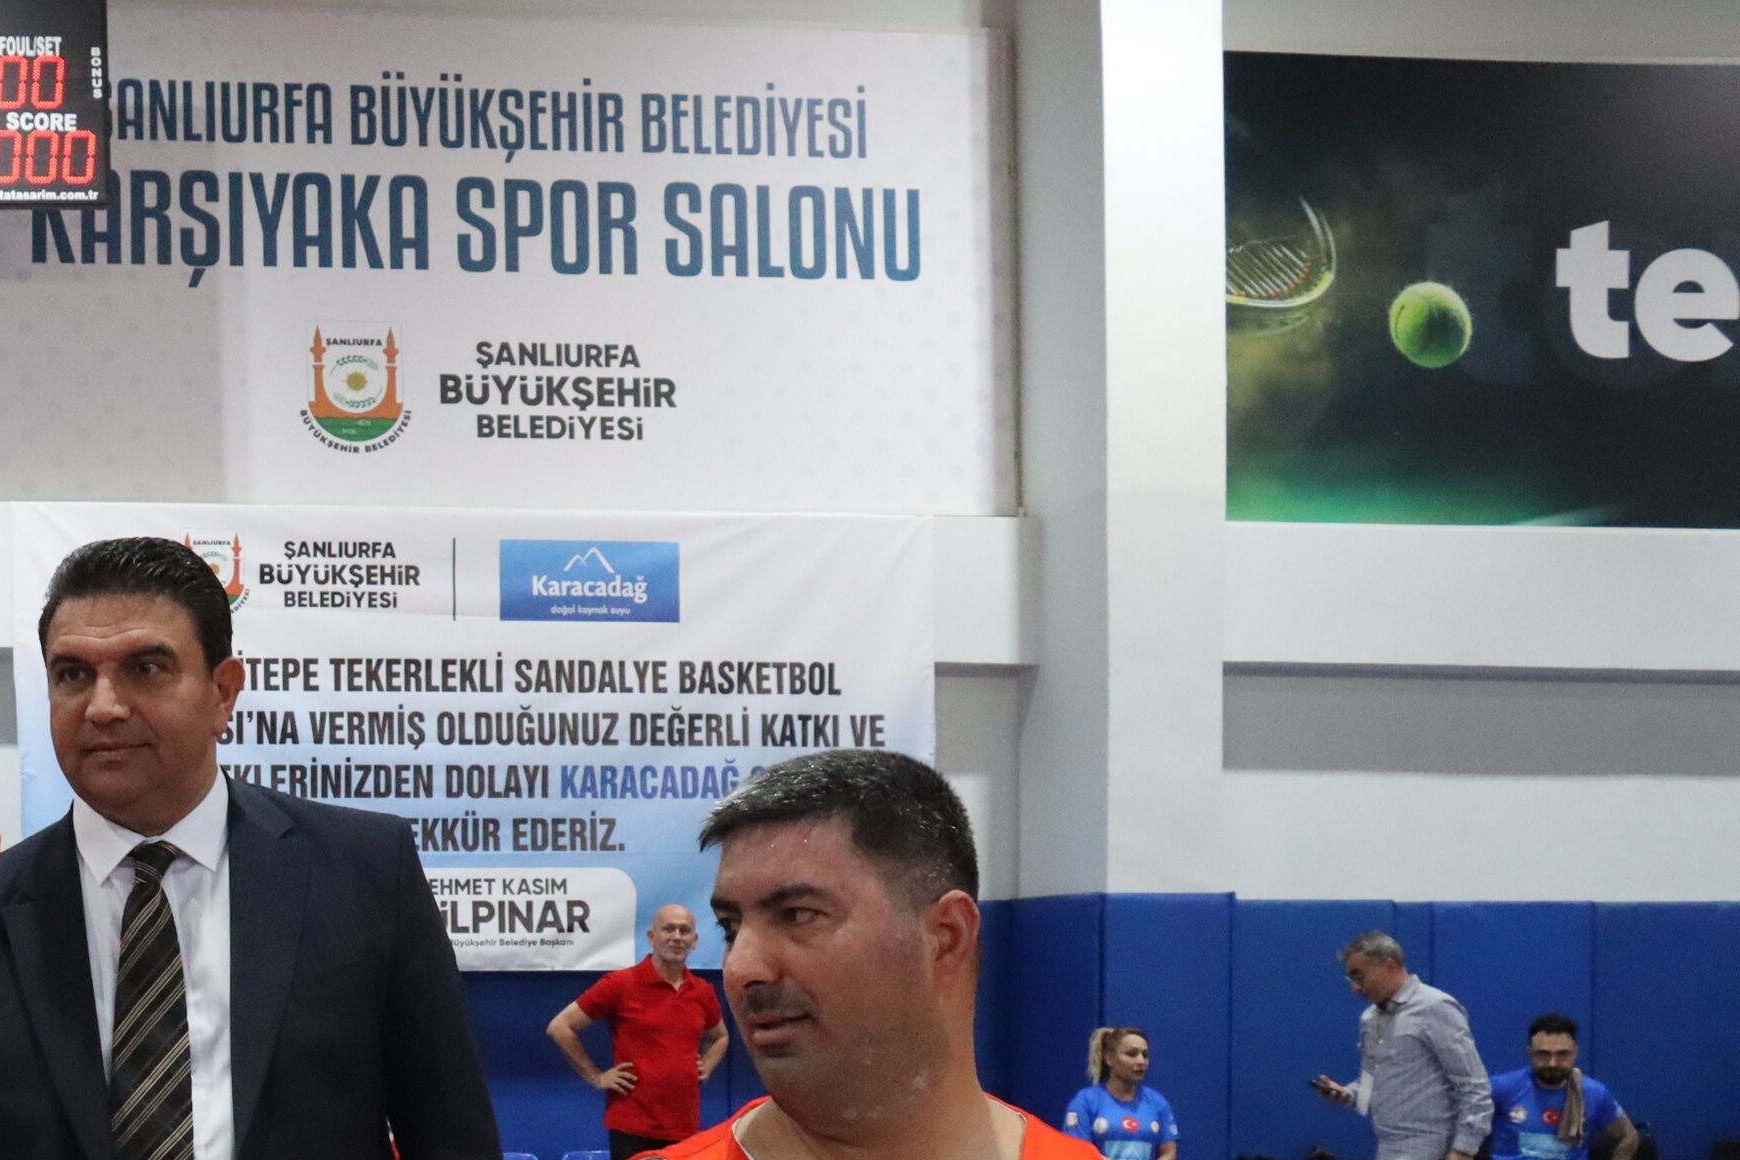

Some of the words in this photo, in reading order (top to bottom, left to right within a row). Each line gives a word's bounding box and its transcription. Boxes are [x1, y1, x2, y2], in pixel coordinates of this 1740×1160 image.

[91, 47, 102, 98] BONUS
[6, 112, 78, 131] SCORE
[108, 78, 333, 145] ANLIURFA
[350, 71, 624, 163] BÜYÜKŞEHİR
[641, 78, 867, 159] BELEDİYESİ
[31, 169, 429, 288] KARŞIYAKA
[456, 176, 638, 276] SPOR
[663, 181, 921, 282] SALONU
[1556, 220, 1740, 363] te
[476, 341, 640, 369] ŞANLIURFA
[439, 373, 677, 411] BÜYÜKŞEHİR
[477, 414, 644, 441] BELEDİYESİ
[284, 540, 396, 560] ŞANLIURFA
[259, 563, 421, 588] BÜYÜKŞEHİR
[532, 575, 648, 604] Karacadağ
[283, 589, 398, 609] BELEDİYESİ
[329, 651, 503, 693] TEKERLEKLİ
[514, 658, 668, 694] SANDALYE
[679, 661, 842, 696] BASKETBOL
[308, 704, 426, 750] VERMİŞ
[436, 704, 620, 746] OLDUĞUNUZ
[629, 705, 750, 748] DEĞERLİ
[761, 714, 840, 748] KATKI
[850, 714, 886, 748] VE
[446, 764, 549, 799] DOLAYI
[561, 758, 739, 800] KARACADAĞ
[512, 810, 626, 852] EDERİZ.
[502, 878, 568, 895] KASIM
[499, 938, 538, 947] Belediye
